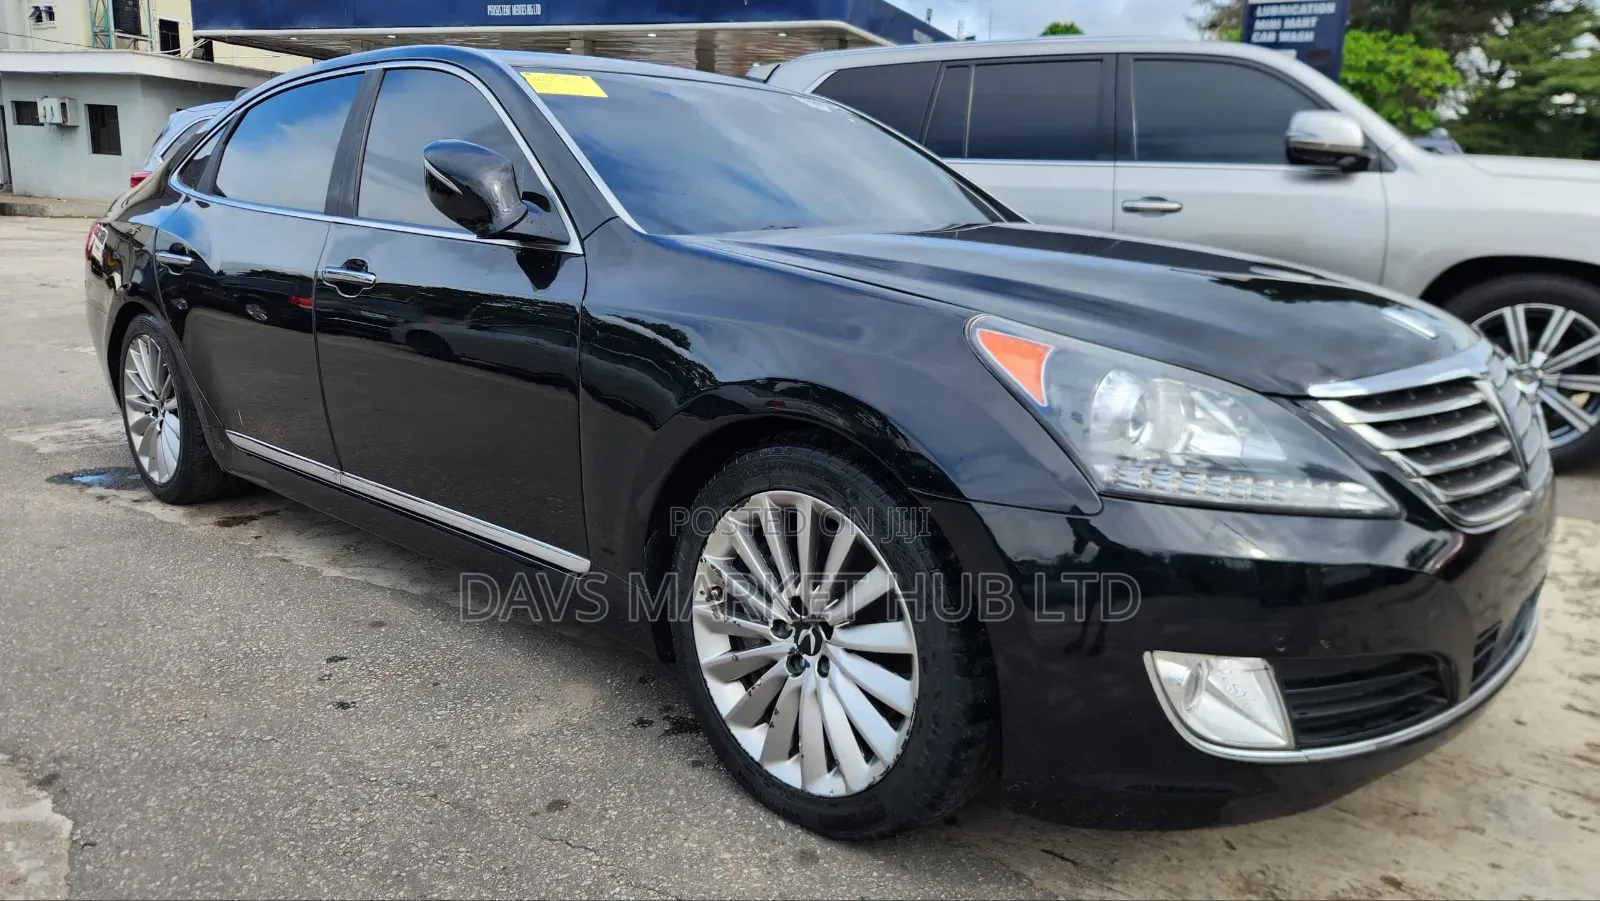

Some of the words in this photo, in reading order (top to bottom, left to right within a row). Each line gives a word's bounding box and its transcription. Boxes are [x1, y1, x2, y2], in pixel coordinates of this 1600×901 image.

[1255, 2, 1336, 17] LUBRICATION
[1254, 18, 1282, 30] MINI
[1283, 16, 1318, 30] MART
[1251, 31, 1277, 42] CAR
[1278, 31, 1315, 42] WASH
